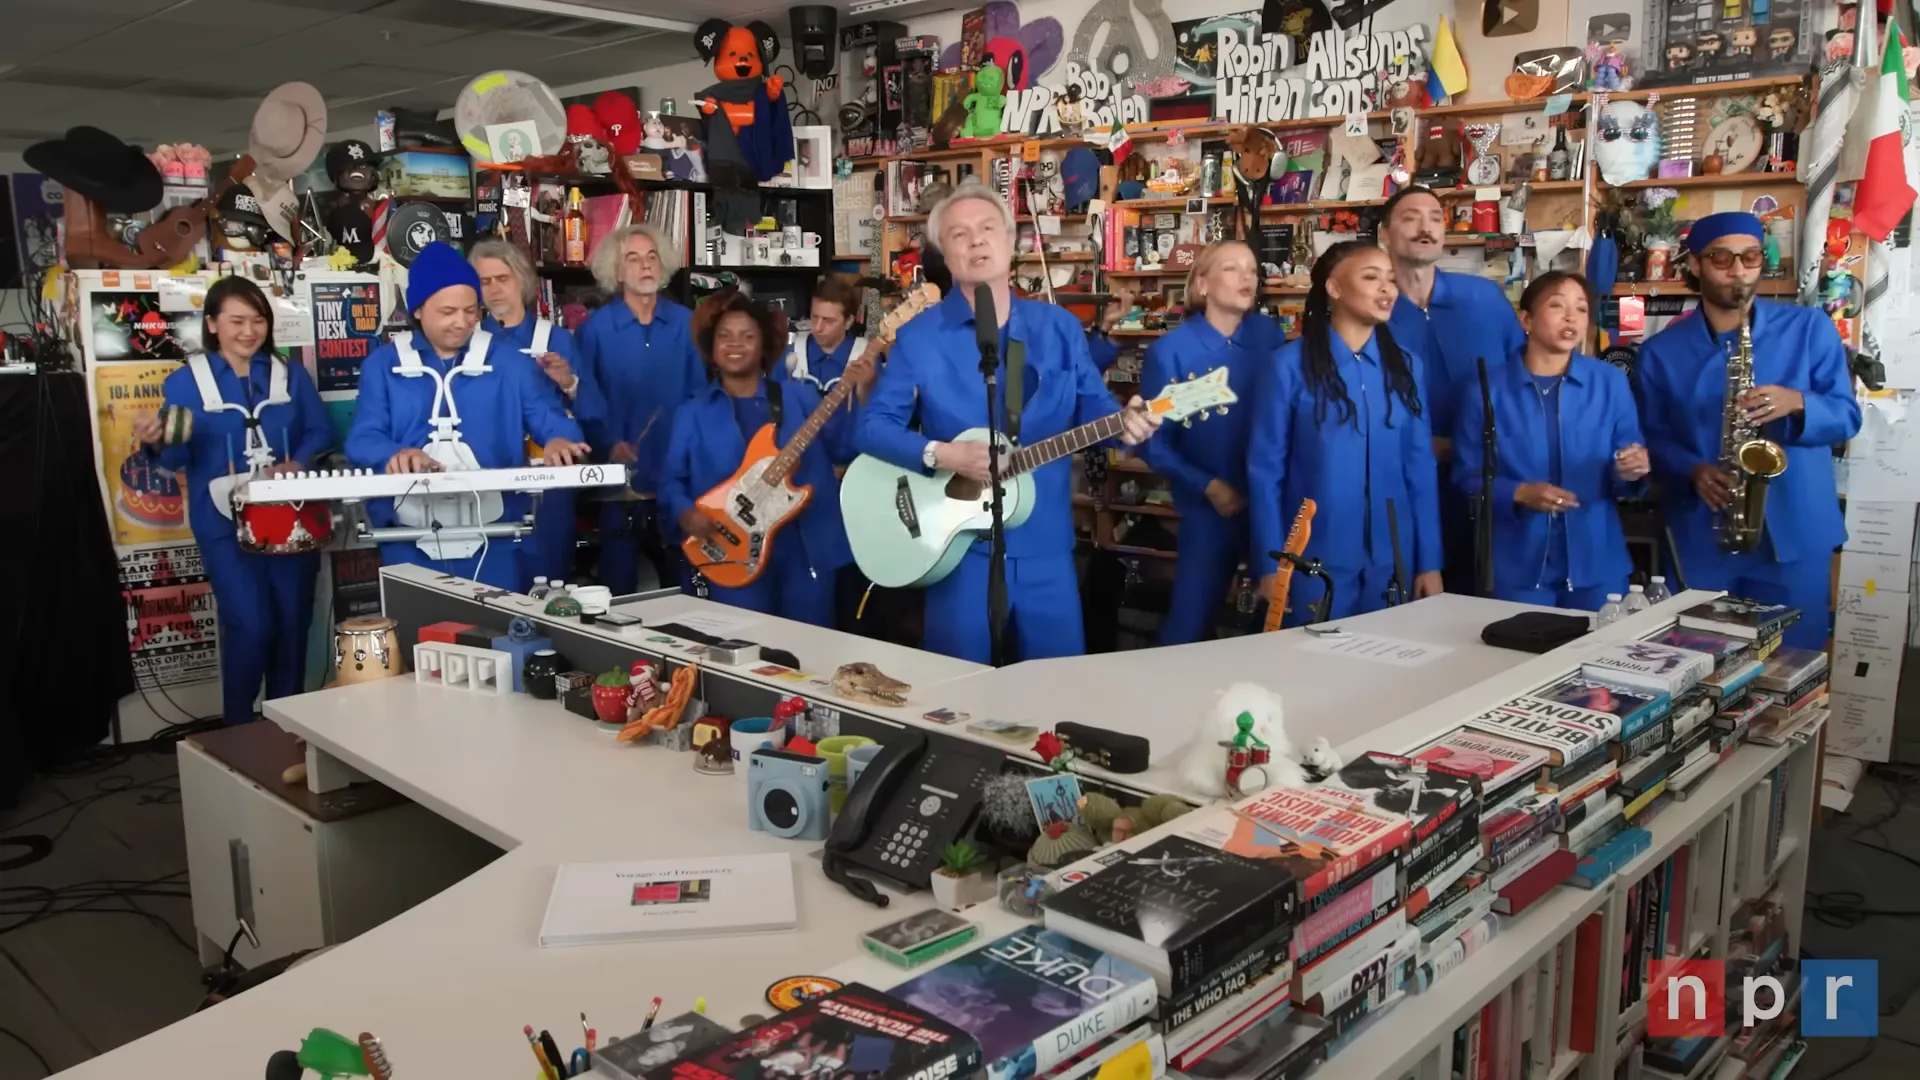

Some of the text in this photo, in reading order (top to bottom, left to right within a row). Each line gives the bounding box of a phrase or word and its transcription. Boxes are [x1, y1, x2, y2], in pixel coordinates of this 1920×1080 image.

[1217, 26, 1289, 79] Robin
[1066, 58, 1109, 100] Bob
[1000, 85, 1066, 133] NPR
[1217, 71, 1305, 123] Hilton
[479, 202, 498, 212] music
[342, 228, 361, 243] M
[316, 301, 343, 321] TINY
[352, 303, 379, 317] ON THE
[133, 322, 156, 330] NHK
[318, 319, 348, 340] DESK
[355, 317, 376, 331] ROAD
[318, 338, 368, 359] CONTEST
[513, 473, 556, 483] ARTURIA
[145, 623, 162, 635] la
[168, 616, 215, 632] tengo
[164, 652, 195, 664] OPEN
[1504, 698, 1614, 731] STONES
[1477, 711, 1590, 746] BEATLES
[1258, 791, 1325, 816] MUSIC
[1241, 801, 1367, 846] HOW WOMEN
[1324, 807, 1389, 834] MADE
[989, 937, 1125, 1000] DUKE
[1351, 952, 1390, 998] OZZY
[1172, 972, 1248, 1027] THE WHO FAQ
[1055, 1011, 1107, 1055] DUKE
